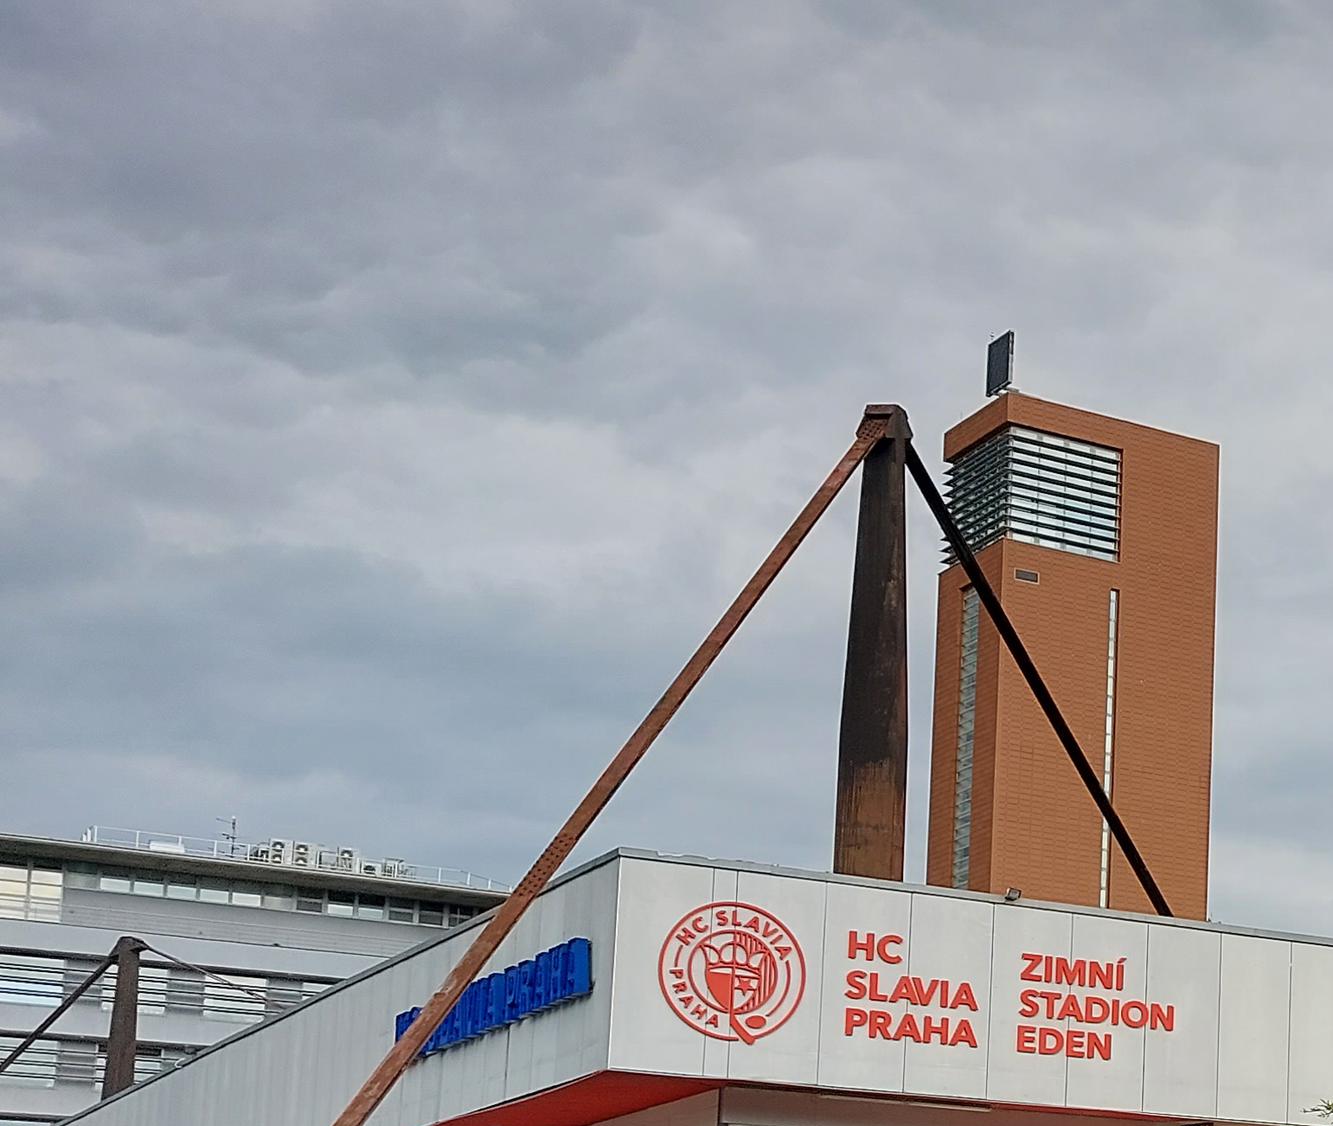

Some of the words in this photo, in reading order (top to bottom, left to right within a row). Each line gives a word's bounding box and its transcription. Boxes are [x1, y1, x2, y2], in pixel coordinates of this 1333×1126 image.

[676, 916, 709, 946] HC
[715, 910, 792, 960] SLAVIA
[847, 930, 903, 964] HC
[844, 970, 978, 1011] SLAVIA
[1020, 953, 1127, 991] ZIMNÍ
[670, 967, 719, 1029] PRAHA
[1018, 989, 1175, 1032] STADION
[844, 1007, 978, 1048] PRAHA
[1017, 1025, 1112, 1060] EDEN
